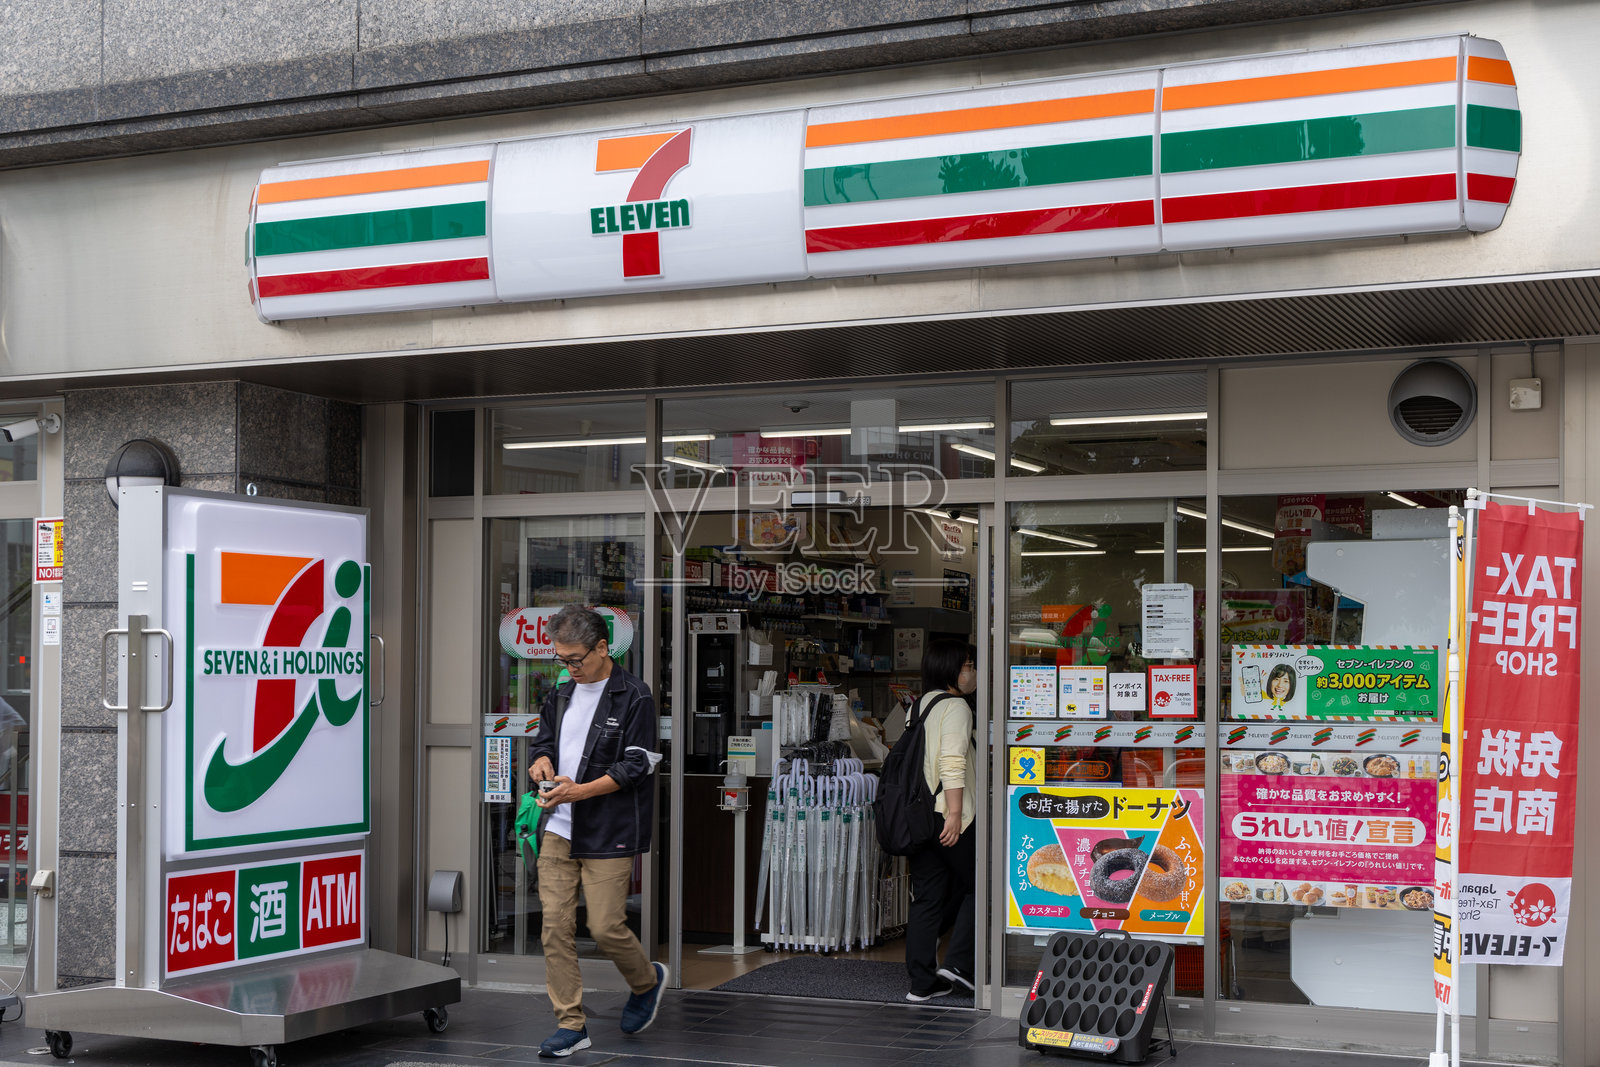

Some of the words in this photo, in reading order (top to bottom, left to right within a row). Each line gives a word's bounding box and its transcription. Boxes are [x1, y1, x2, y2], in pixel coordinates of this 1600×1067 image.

[283, 651, 364, 675] HOLDINGS
[1154, 674, 1191, 682] TAX-FREE
[1316, 673, 1430, 689] 約3,000アイテム
[1358, 692, 1389, 704] お届け
[1256, 787, 1401, 803] 確かな品質をお求めやすく!
[1026, 797, 1103, 815] お店で揚げた
[1114, 796, 1192, 820] ドーナツ
[1257, 847, 1400, 860] 納得のおいしさや便利をお手ごろ価格でご提供
[1017, 834, 1034, 891] なめらか
[171, 888, 232, 955] たばこ
[250, 880, 288, 943] 酒
[306, 871, 357, 931] ATM
[1028, 906, 1064, 916] カスタード
[1092, 910, 1116, 918] チョコ
